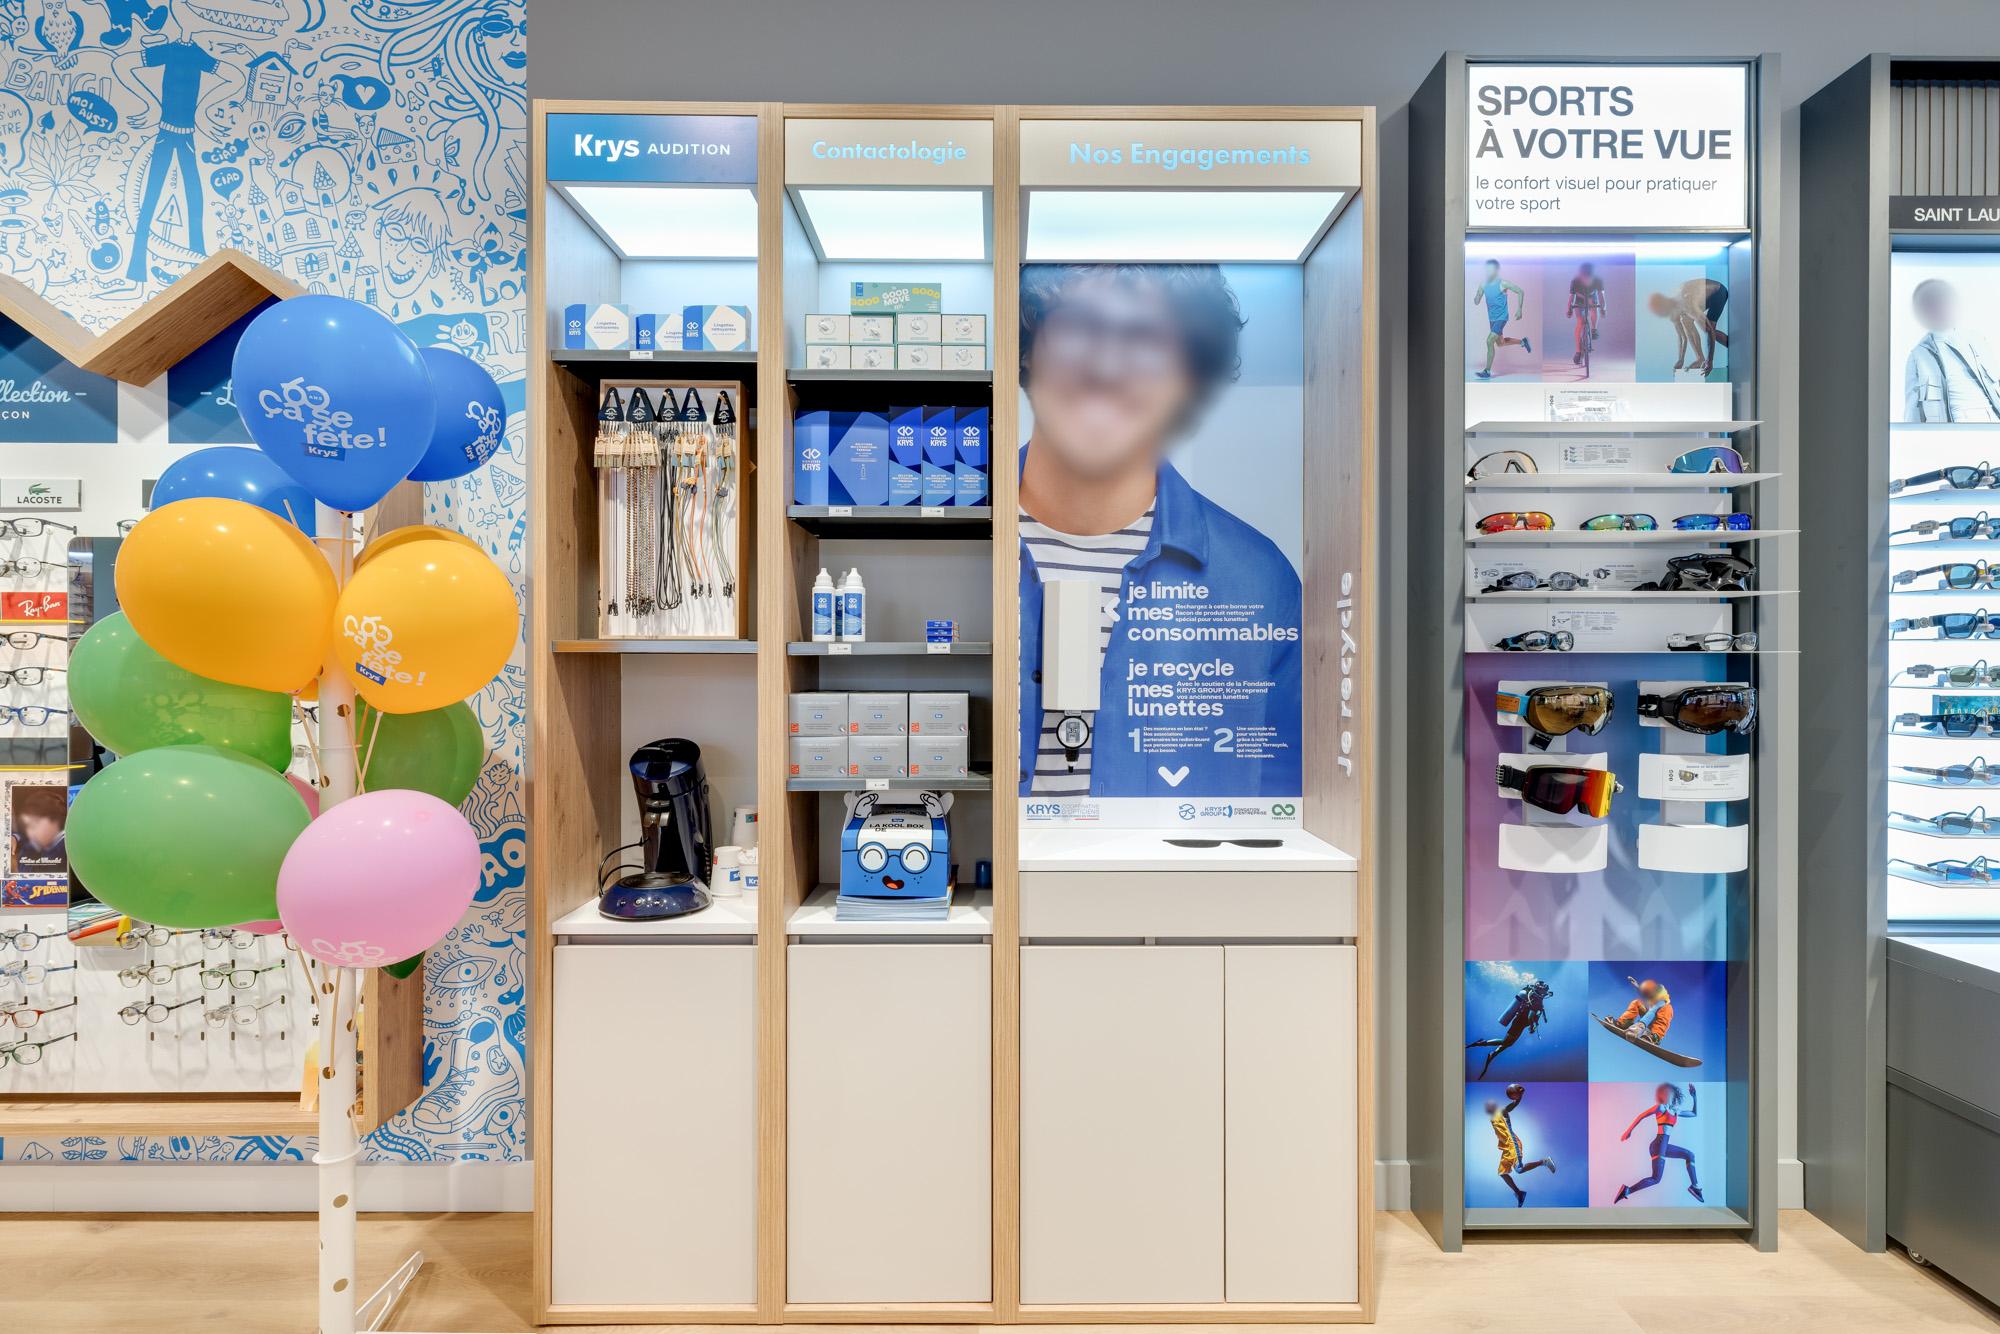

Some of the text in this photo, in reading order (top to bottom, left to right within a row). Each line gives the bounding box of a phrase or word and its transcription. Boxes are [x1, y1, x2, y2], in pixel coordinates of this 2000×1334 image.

[70, 96, 94, 110] MOI
[1477, 85, 1634, 116] SPORTS
[78, 108, 112, 131] AUSSI
[574, 134, 730, 162] Krys AUDITION
[1476, 120, 1732, 160] À VOTRE VUE
[812, 140, 968, 165] Contactologie
[1069, 143, 1312, 170] Nos Engagements
[1476, 176, 1718, 193] le confort visuel pour pratiquer
[1476, 198, 1560, 212] votre sport
[1914, 208, 1963, 222] SAINT
[312, 408, 353, 429] se
[308, 446, 339, 458] Krys
[17, 496, 62, 504] LACOSTE
[1127, 581, 1209, 603] je limite
[18, 596, 61, 617] Ray-Ban
[1128, 606, 1174, 621] mes
[1128, 623, 1298, 641] consommables
[1337, 572, 1356, 717] recycle
[360, 666, 381, 682] Krys
[1126, 658, 1234, 680] je recycle
[1128, 683, 1174, 698] mes
[1128, 698, 1224, 716] lunettes
[1128, 728, 1140, 752] 1
[1214, 728, 1233, 752] 2
[1026, 804, 1060, 814] KRYS
